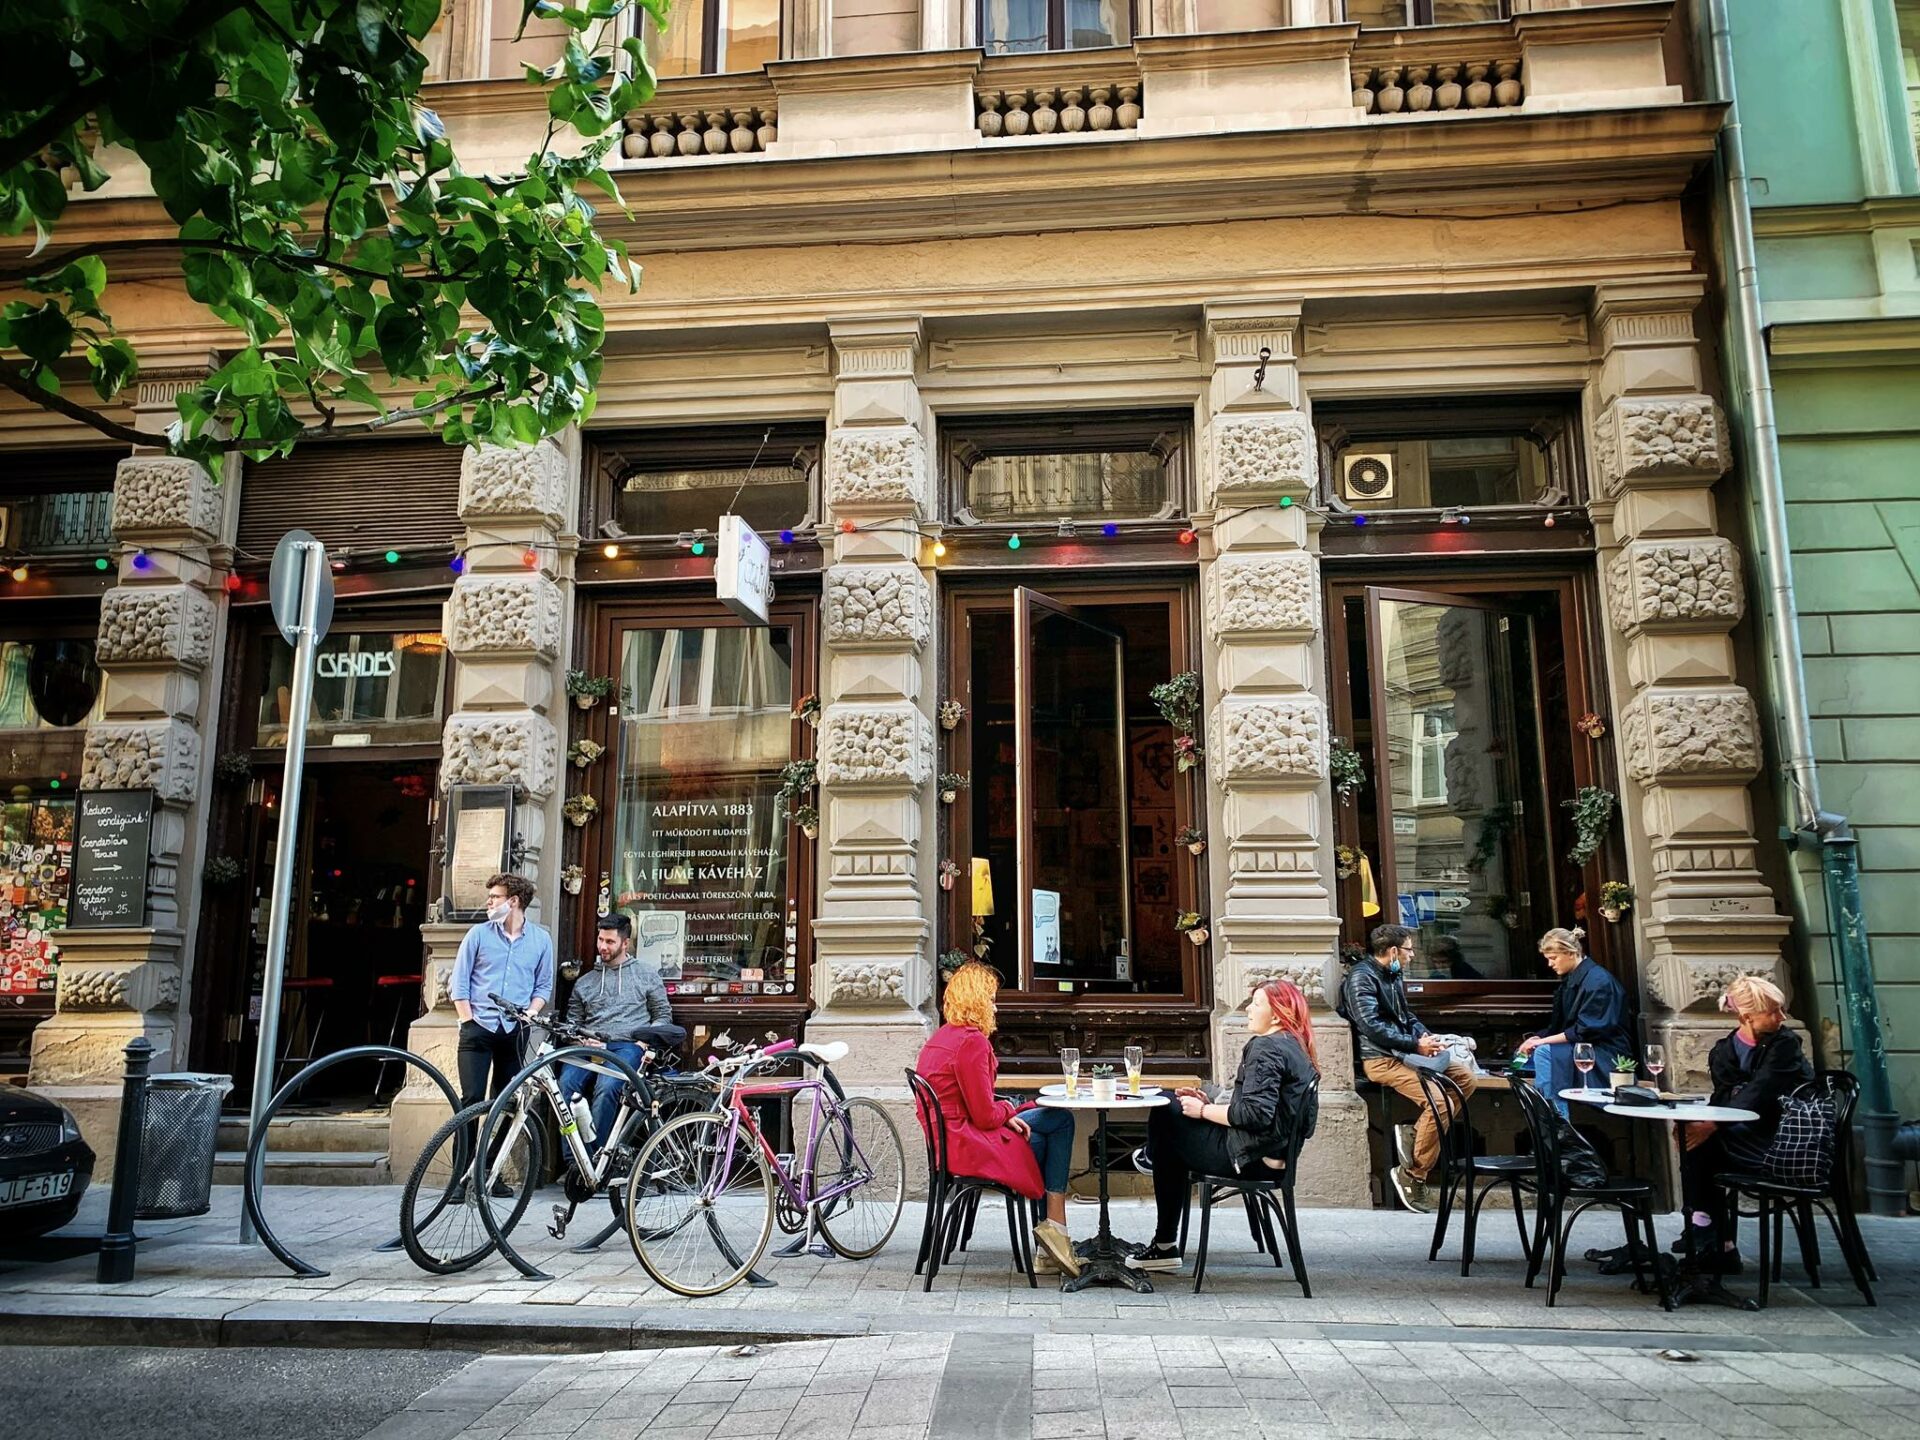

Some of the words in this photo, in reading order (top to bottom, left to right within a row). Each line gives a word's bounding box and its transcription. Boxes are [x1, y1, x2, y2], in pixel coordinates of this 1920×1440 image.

[316, 651, 396, 678] CSENDES
[83, 799, 113, 816] Kedves
[652, 802, 718, 817] ALAPÍTVA
[723, 804, 754, 816] 1883
[713, 828, 751, 836] BUDAPEST
[623, 850, 646, 859] EGYIK
[648, 849, 696, 858] LEGHÍRESEBB
[698, 849, 736, 857] IRODALMI
[738, 848, 779, 857] KÁVÉHÁZA
[637, 869, 647, 880] A
[651, 867, 695, 880] FIUME
[698, 864, 763, 880] KÁVÉHÁZ
[76, 883, 114, 895] Csendes
[643, 890, 700, 900] POETICÁNKKAL
[754, 890, 777, 900] ARRA,
[115, 903, 131, 914] 25.
[696, 954, 733, 963] LÉTTEREM
[0, 1174, 71, 1204] JLF-619
